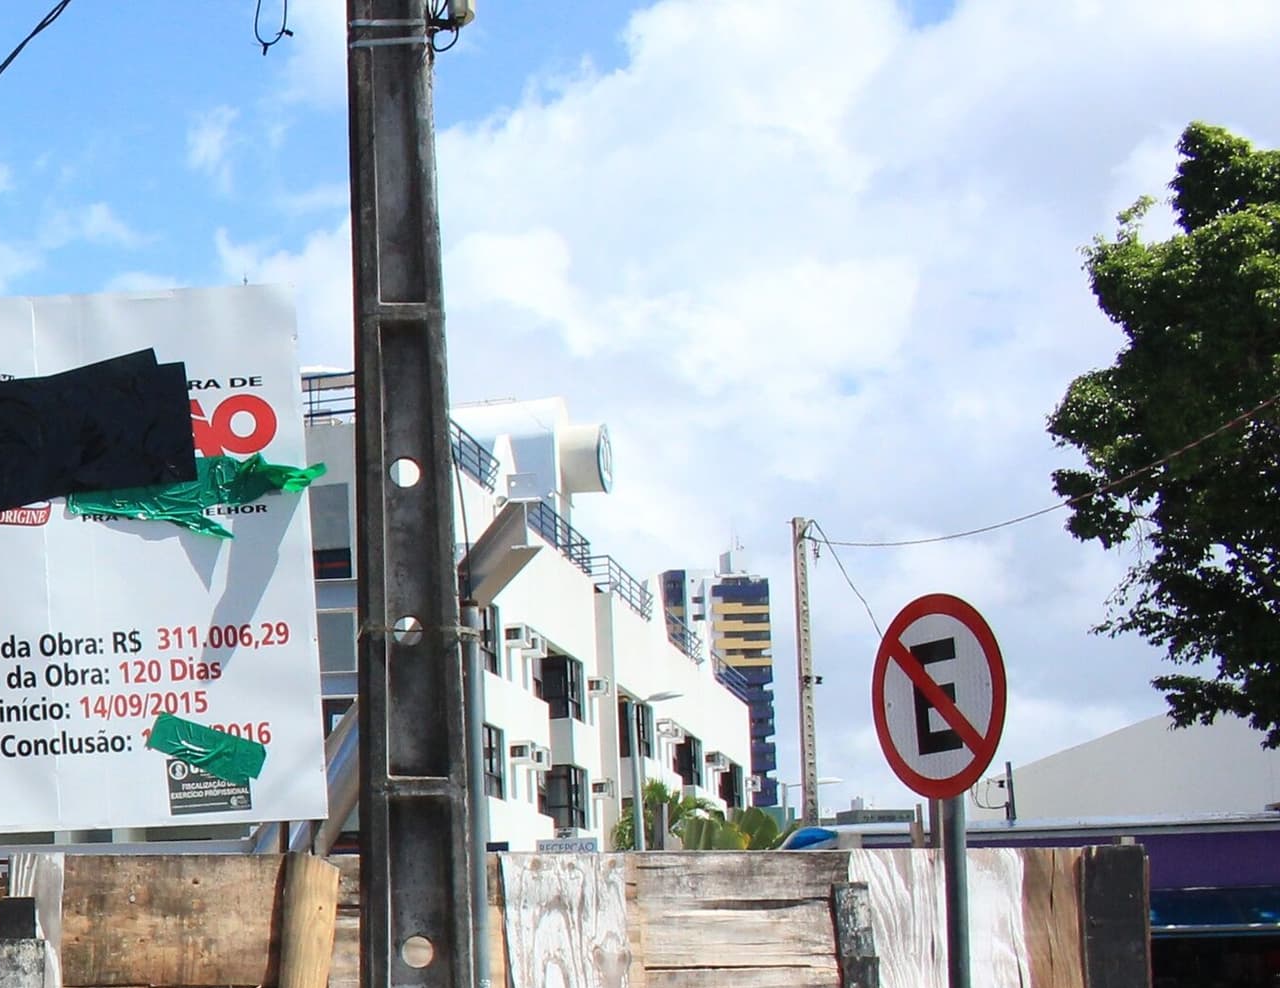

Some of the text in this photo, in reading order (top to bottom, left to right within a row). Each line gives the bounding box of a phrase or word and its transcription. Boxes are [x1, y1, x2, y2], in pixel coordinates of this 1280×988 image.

[229, 376, 263, 388] DE
[206, 504, 268, 516] ELHOR
[1, 635, 31, 659] da
[39, 632, 105, 657] Obra:
[112, 629, 142, 654] R$
[157, 621, 290, 651] 311.006,29
[6, 665, 37, 689] da
[44, 662, 111, 687] Obra:
[119, 661, 162, 684] 120
[170, 657, 222, 682] Dias
[0, 697, 71, 723] início:
[79, 691, 208, 720] 14/09/2015
[0, 730, 133, 757] Conclusão:
